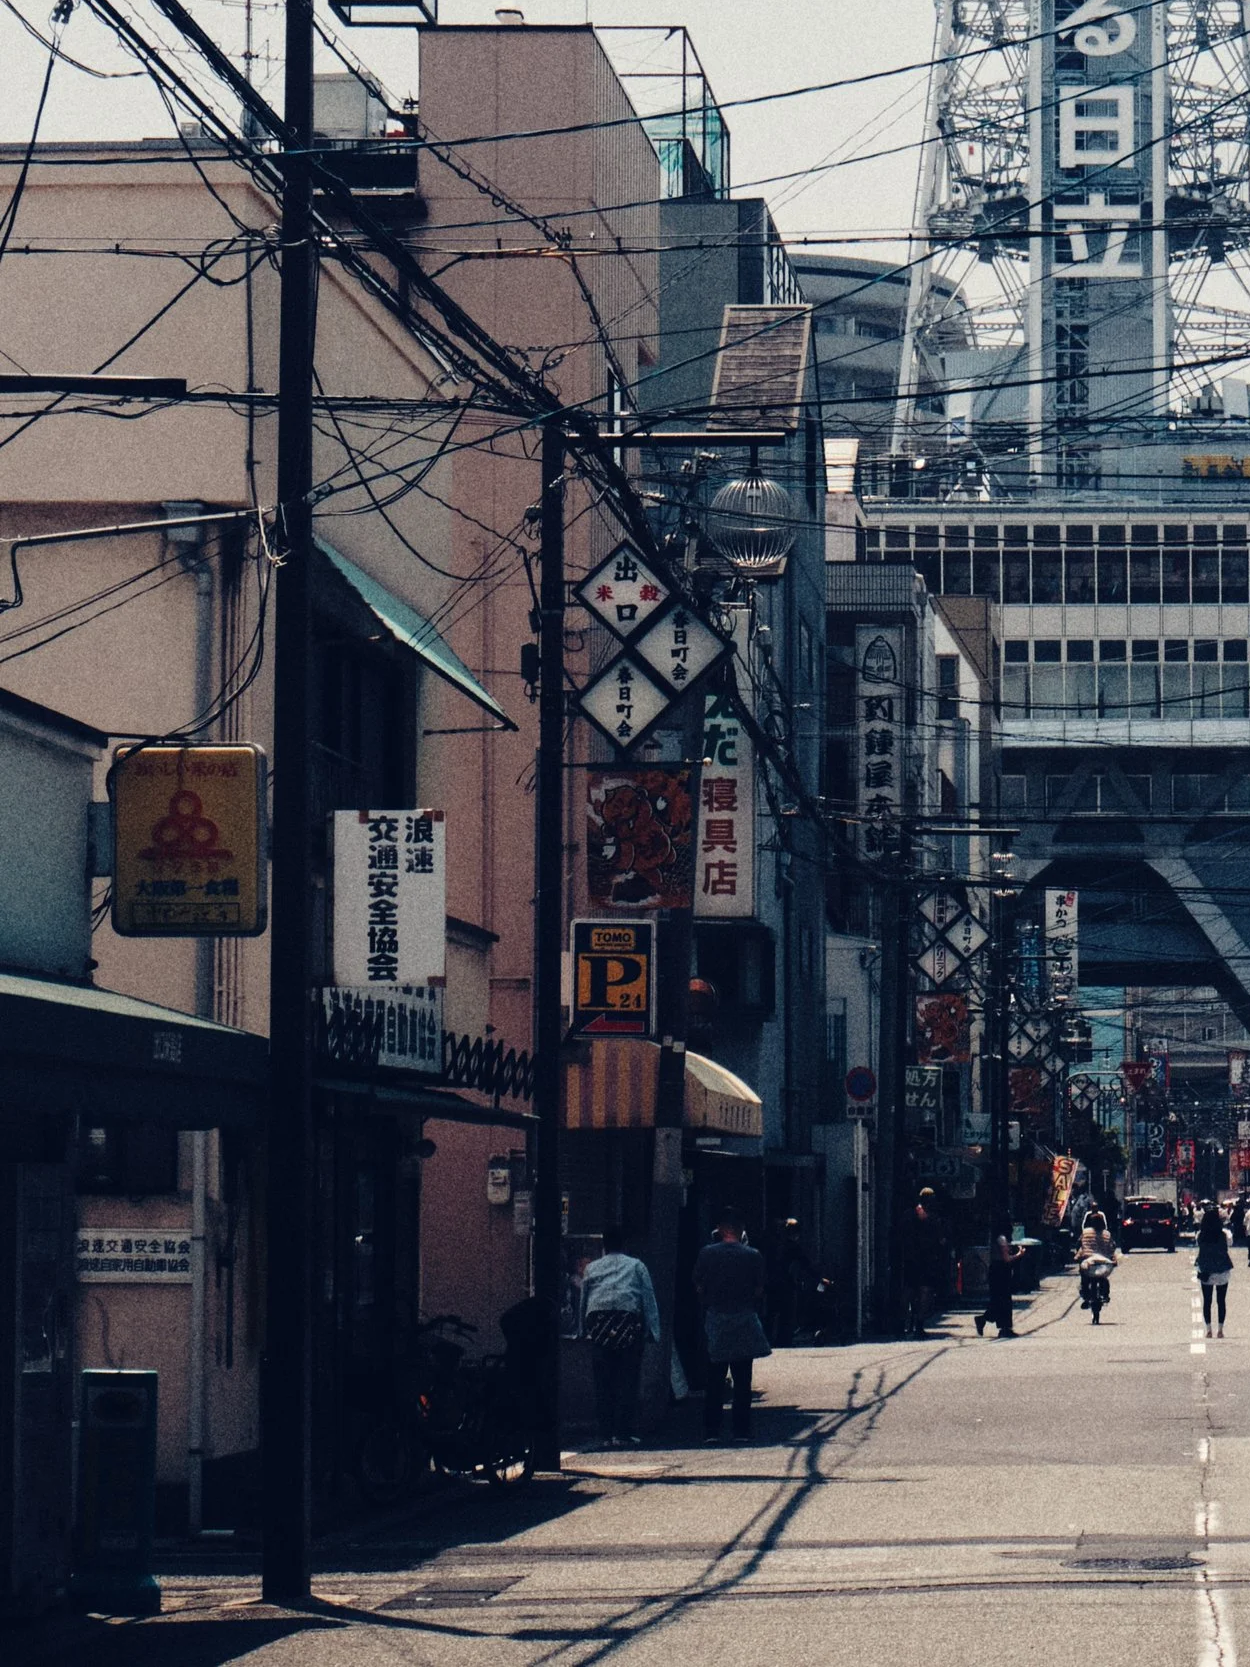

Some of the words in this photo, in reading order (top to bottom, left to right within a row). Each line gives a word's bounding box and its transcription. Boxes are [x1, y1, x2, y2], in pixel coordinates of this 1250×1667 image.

[616, 666, 634, 737] 春日町会
[367, 815, 399, 982] 交通安全協会
[594, 932, 632, 943] TOMO
[581, 956, 642, 1008] P
[1044, 1157, 1076, 1224] SALE
